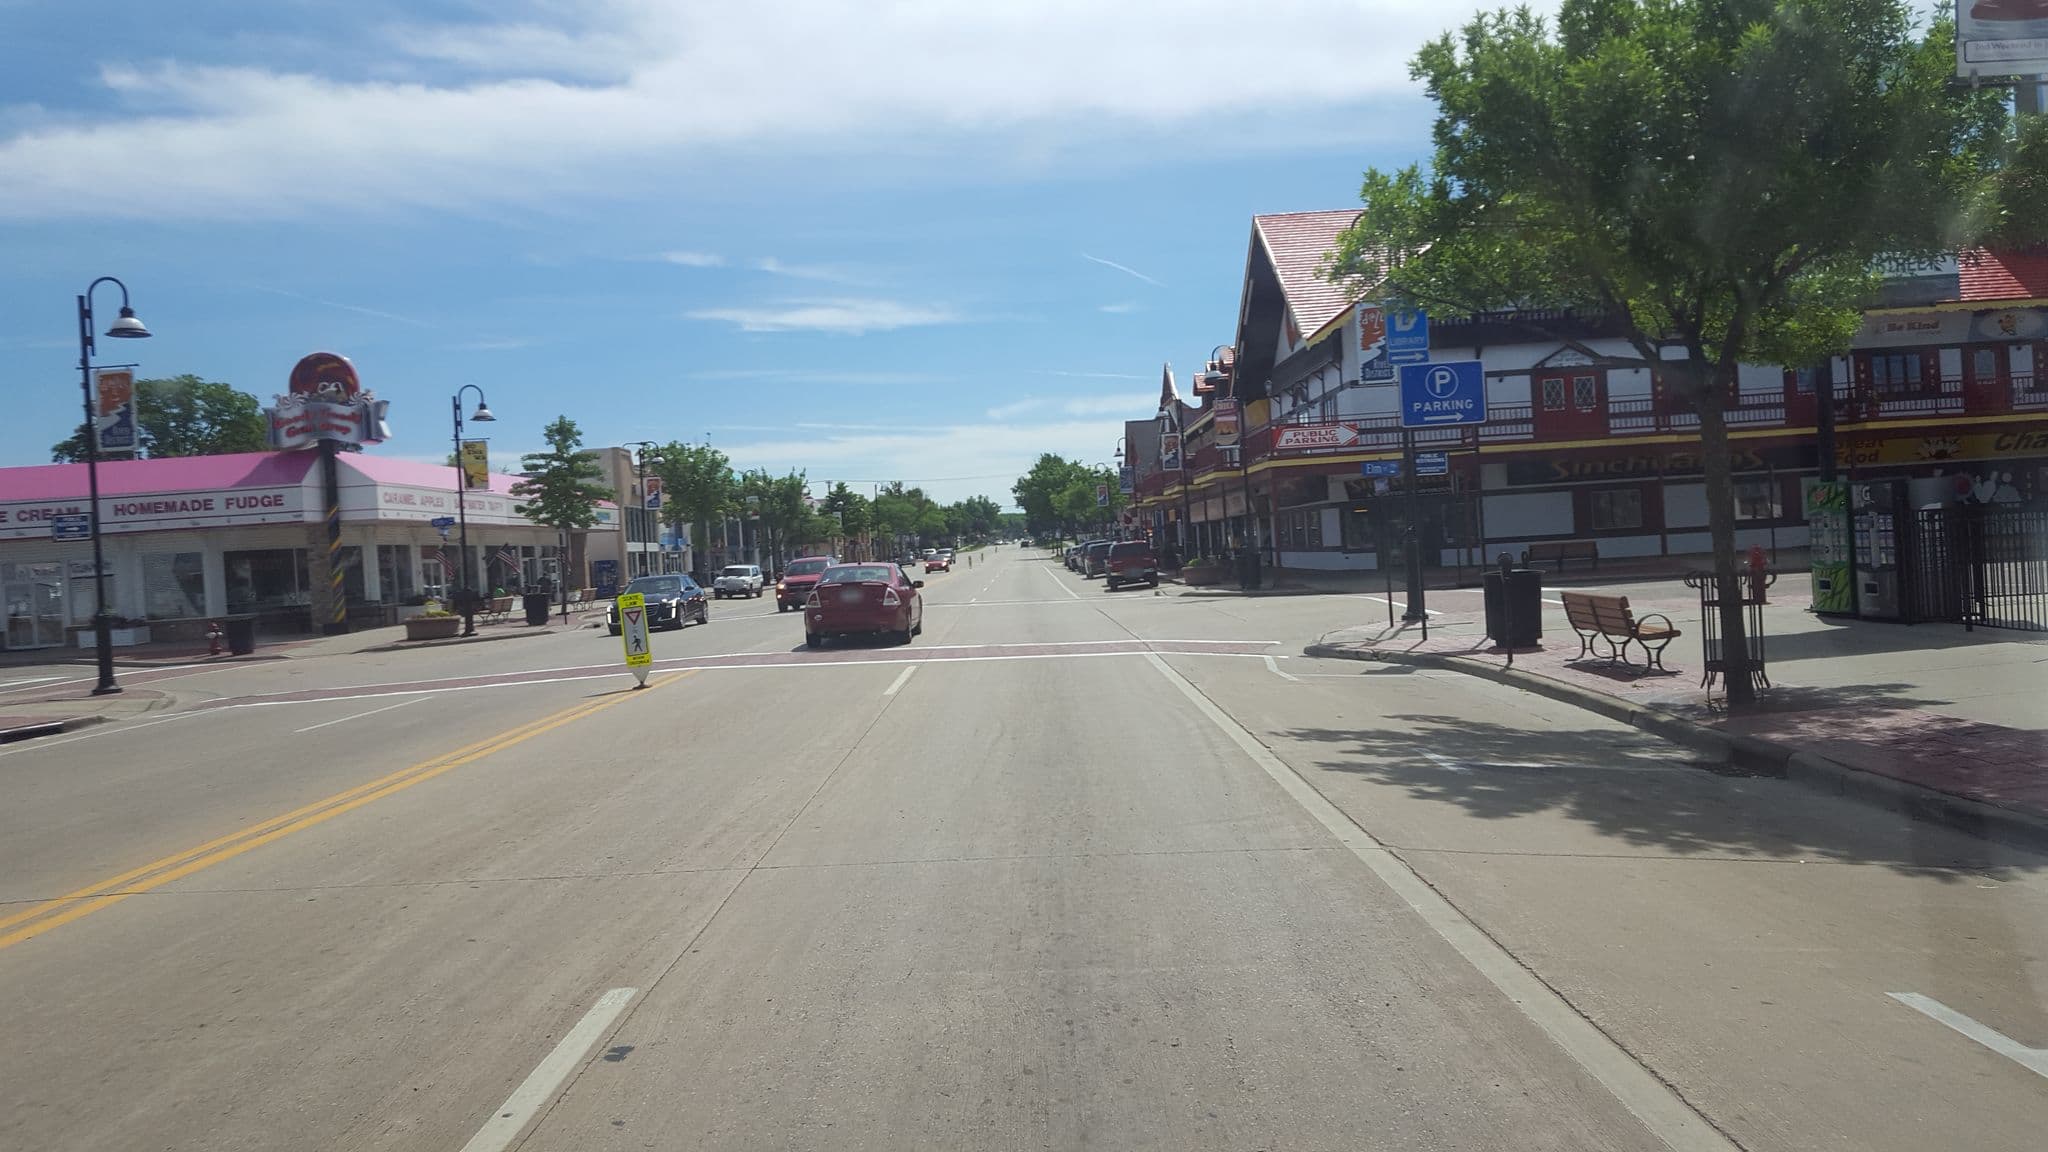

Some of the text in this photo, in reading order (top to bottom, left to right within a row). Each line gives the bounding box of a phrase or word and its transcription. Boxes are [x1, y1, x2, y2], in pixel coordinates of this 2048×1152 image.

[1389, 336, 1425, 346] LIBRARY
[1434, 370, 1451, 394] P
[1413, 399, 1473, 412] PARKING
[1285, 437, 1339, 445] PARKING
[114, 494, 284, 516] HOMEMADE FUDGE
[383, 491, 445, 508] CARAMEL APPLES
[16, 506, 81, 521] CREAM
